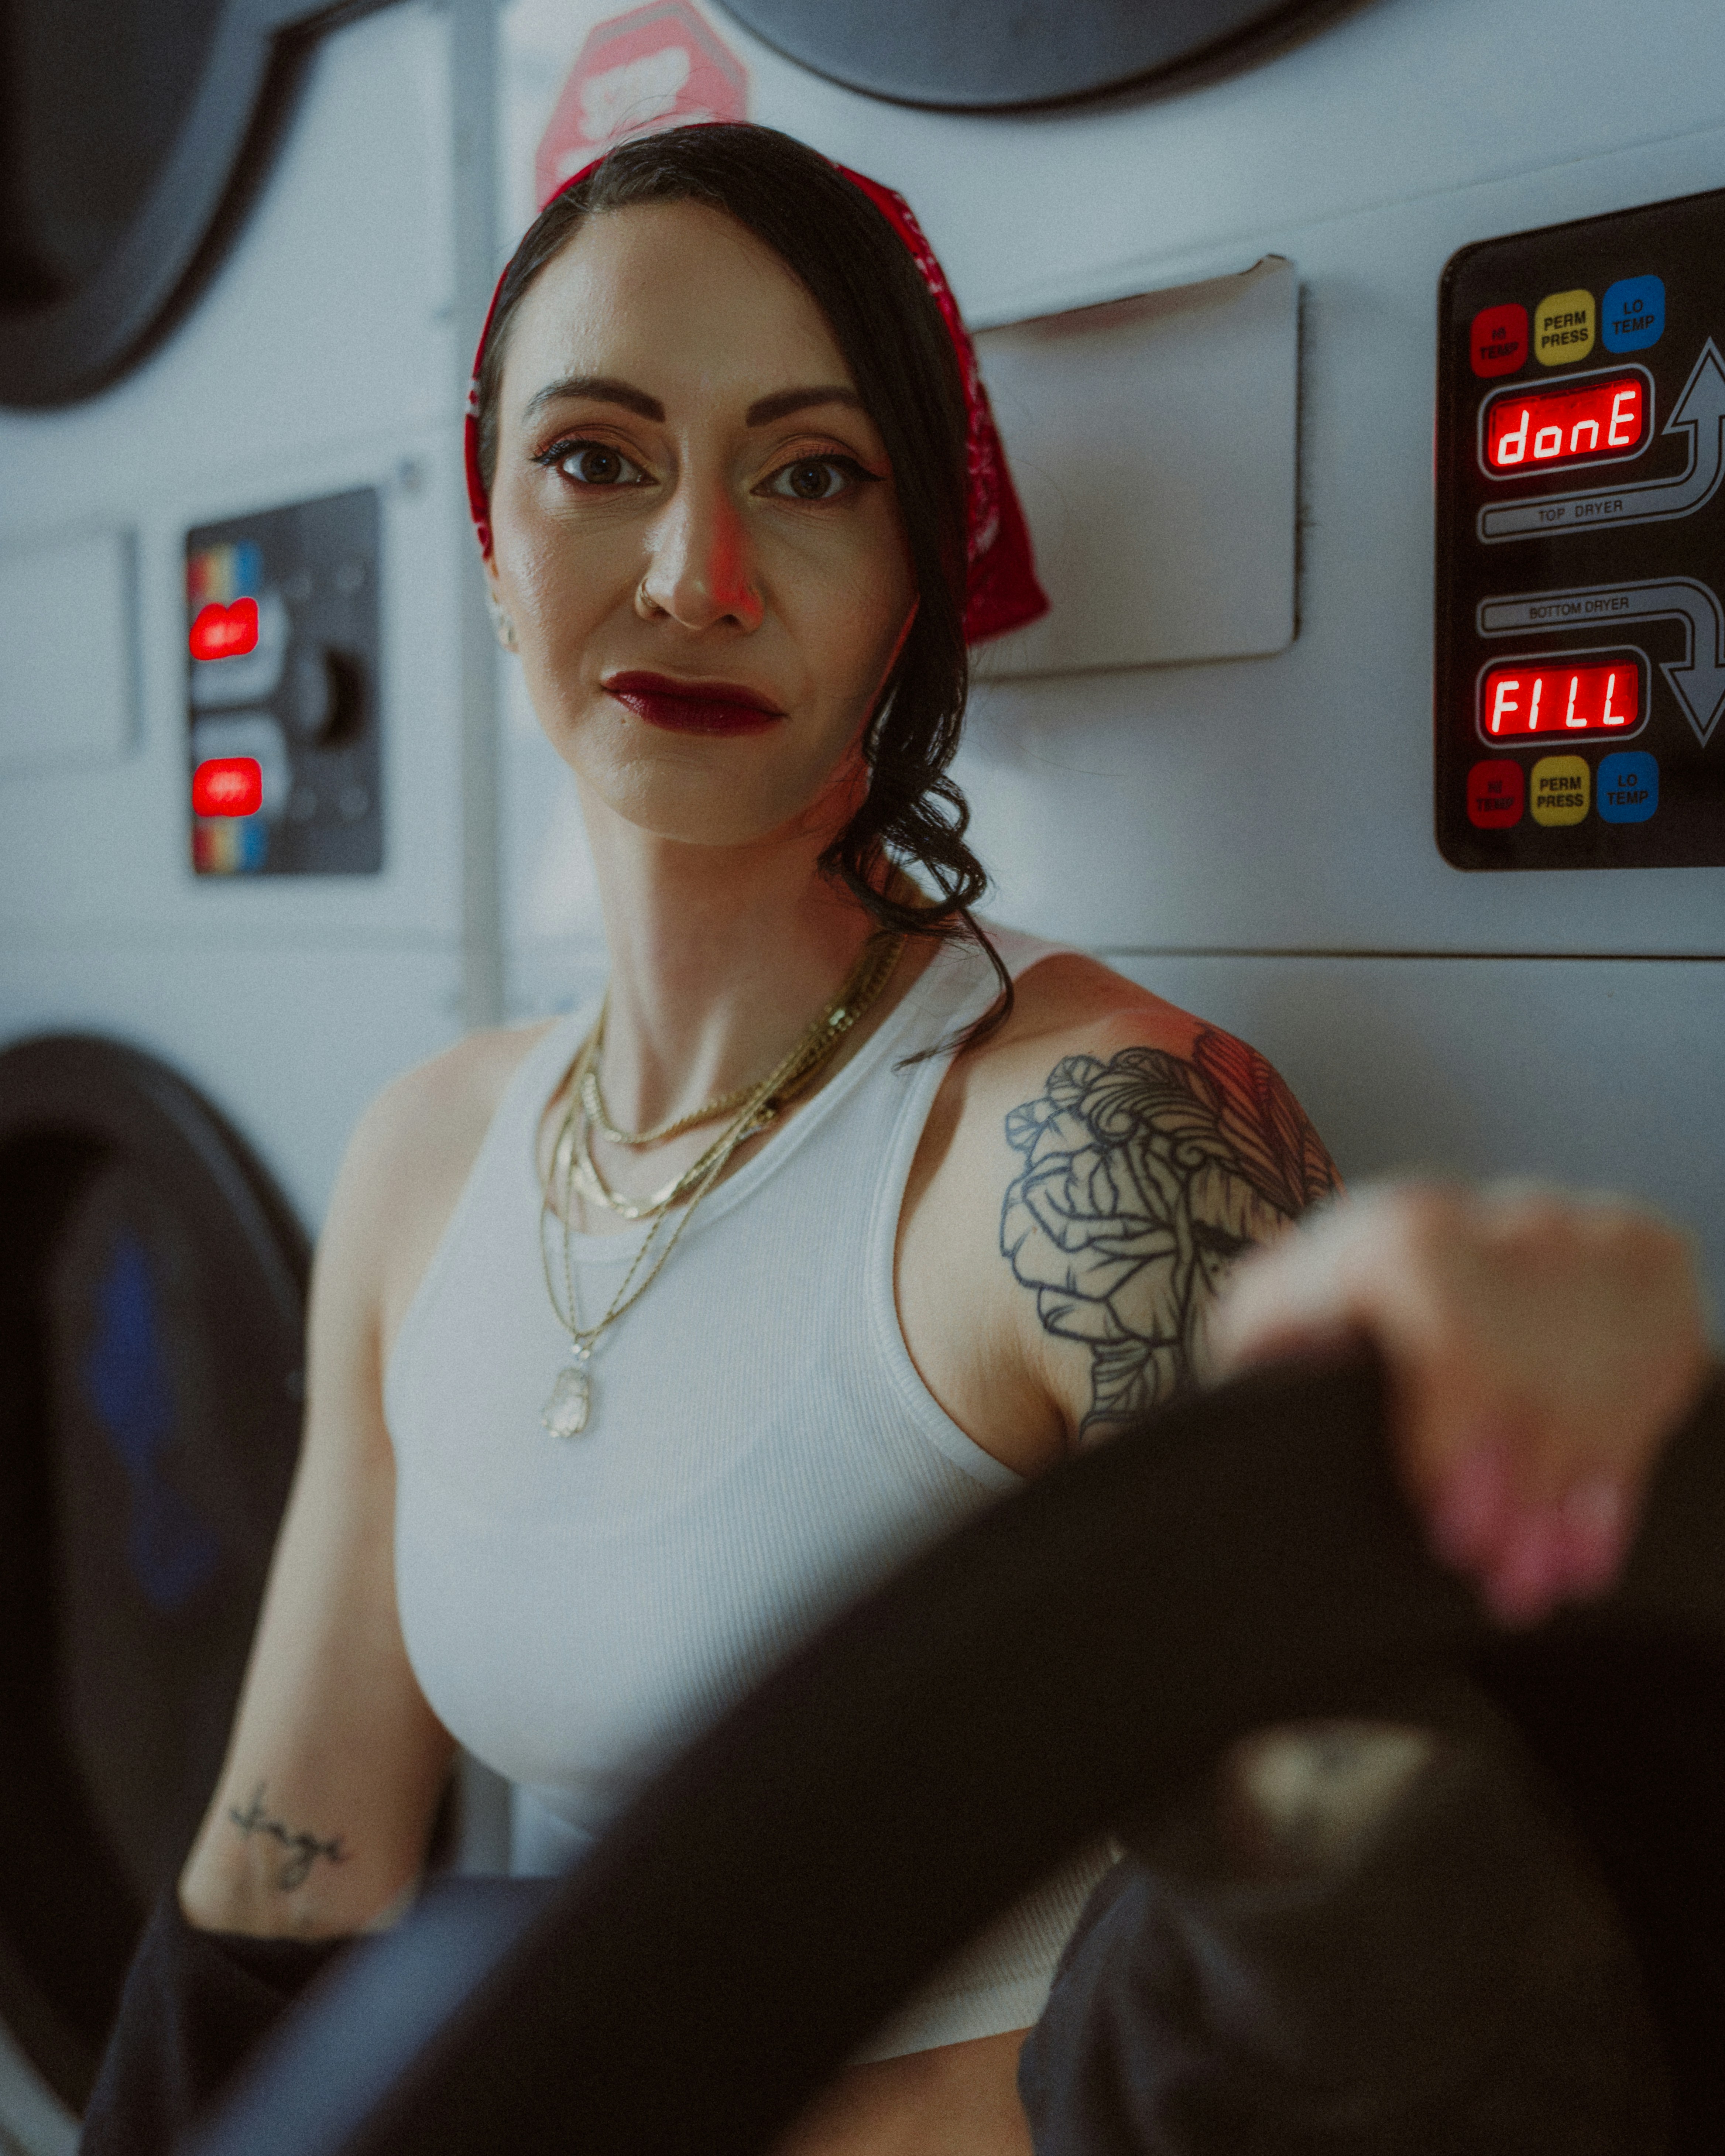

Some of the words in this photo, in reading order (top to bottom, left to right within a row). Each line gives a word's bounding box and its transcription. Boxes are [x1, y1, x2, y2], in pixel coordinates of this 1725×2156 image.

[1623, 299, 1643, 315] LO
[1544, 310, 1586, 331] PERM
[1612, 315, 1654, 335] TEMP
[1541, 328, 1588, 349] PRESS
[1538, 508, 1565, 522] TOP
[1575, 499, 1623, 517] DRYER
[1529, 602, 1582, 619] BOTTOM
[1585, 597, 1630, 613] DRYER
[1492, 673, 1625, 732] FILL
[1540, 776, 1582, 792] PERM
[1618, 773, 1637, 788] LO
[1537, 794, 1584, 808] PRESS
[1606, 789, 1649, 806] TEMP
